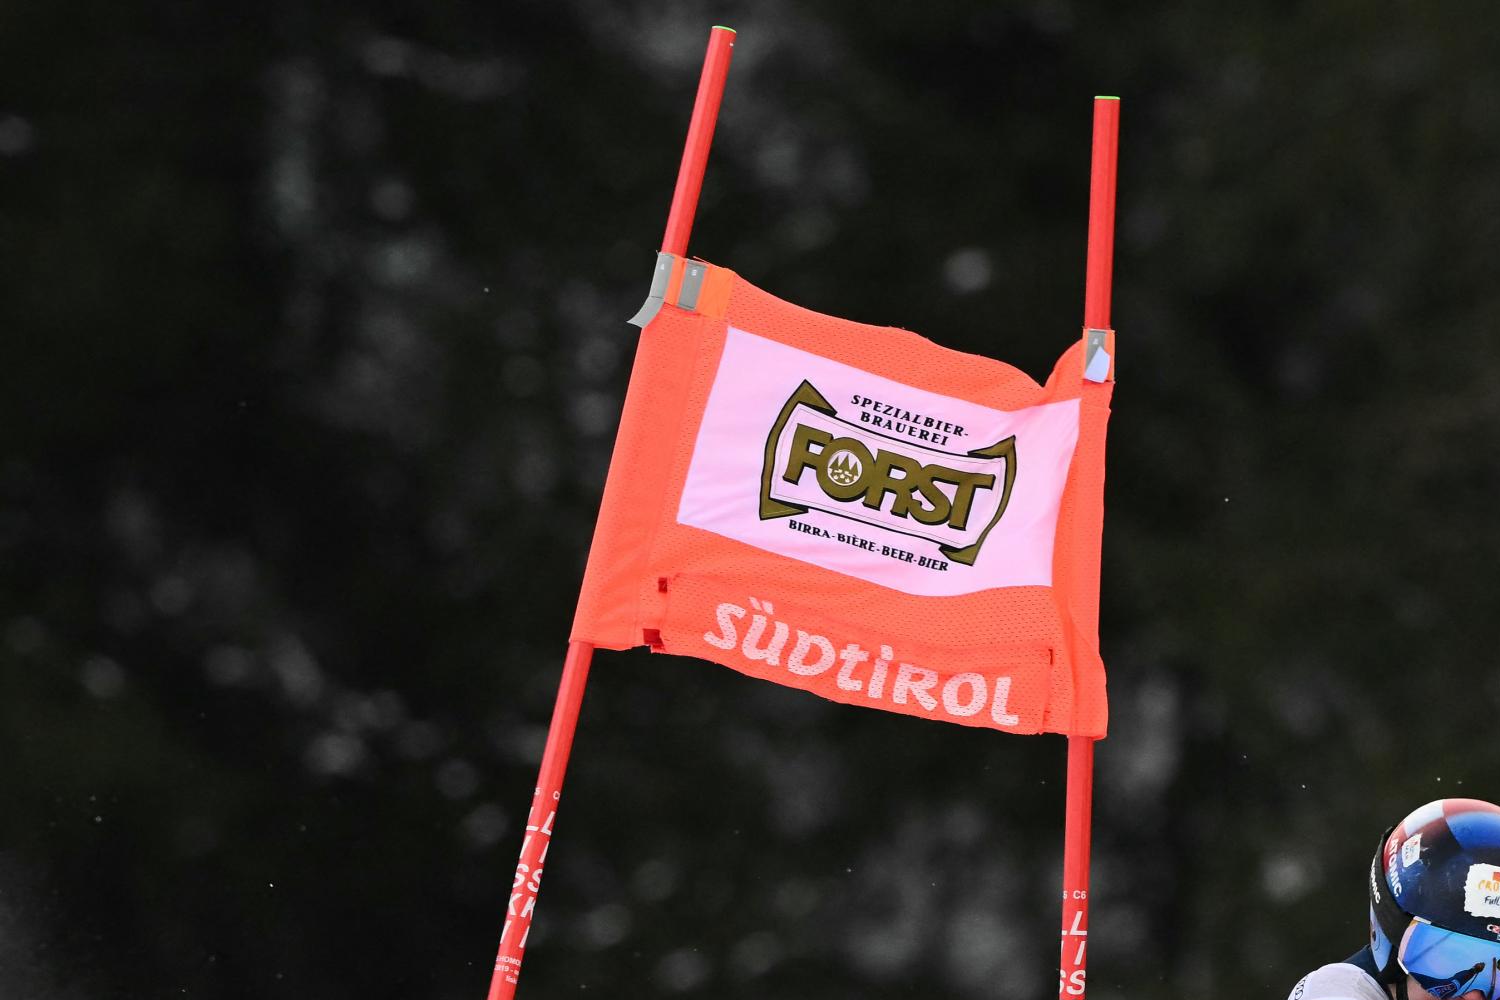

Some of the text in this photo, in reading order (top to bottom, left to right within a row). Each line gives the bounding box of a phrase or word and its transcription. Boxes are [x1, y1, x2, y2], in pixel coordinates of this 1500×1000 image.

[850, 394, 969, 437] SPEZIALBIER-
[860, 411, 949, 446] BRAUEREI
[783, 423, 997, 532] FORST
[1388, 838, 1402, 897] ATOMIC
